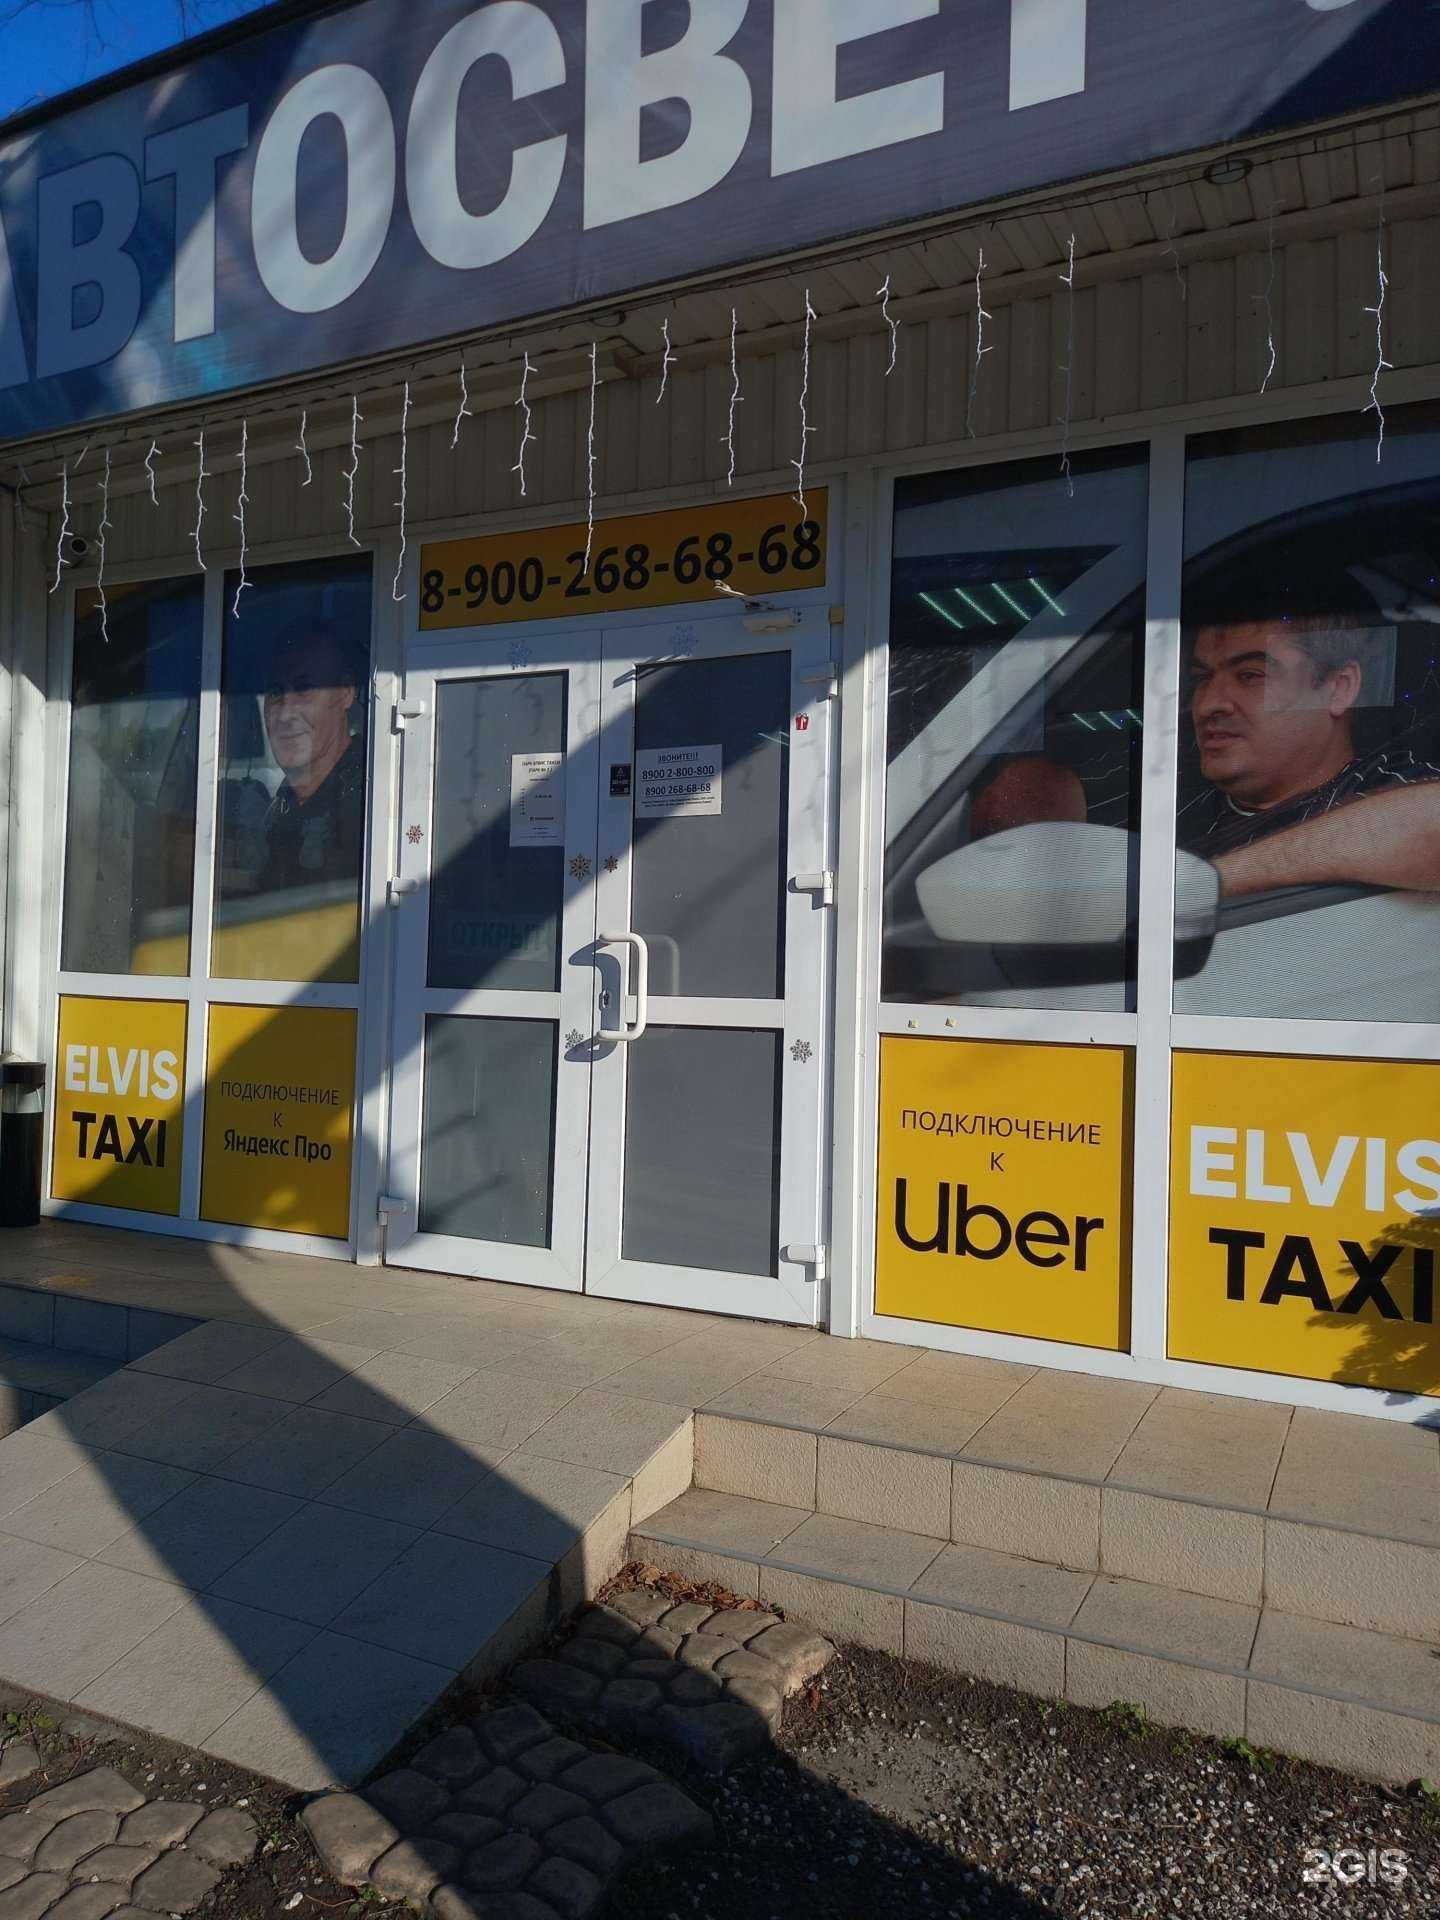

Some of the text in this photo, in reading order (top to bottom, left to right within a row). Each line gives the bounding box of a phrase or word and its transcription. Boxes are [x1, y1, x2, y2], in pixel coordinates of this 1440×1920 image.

[421, 519, 822, 613] 8-900-268-68-68
[642, 765, 715, 780] 8900 2-800-800
[645, 783, 711, 796] 8900 268-68-68
[64, 1044, 178, 1100] ELVIS
[220, 1081, 340, 1105] ПОДКЛЮЧЕНИЕ
[72, 1111, 166, 1168] TAXI
[223, 1129, 332, 1163] Яндекс Про
[901, 1109, 1101, 1145] ПОДКЛЮЧЕНИЕ
[1189, 1125, 1440, 1216] ELVIS
[894, 1177, 1105, 1272] Uber
[1209, 1227, 1434, 1324] TAXI
